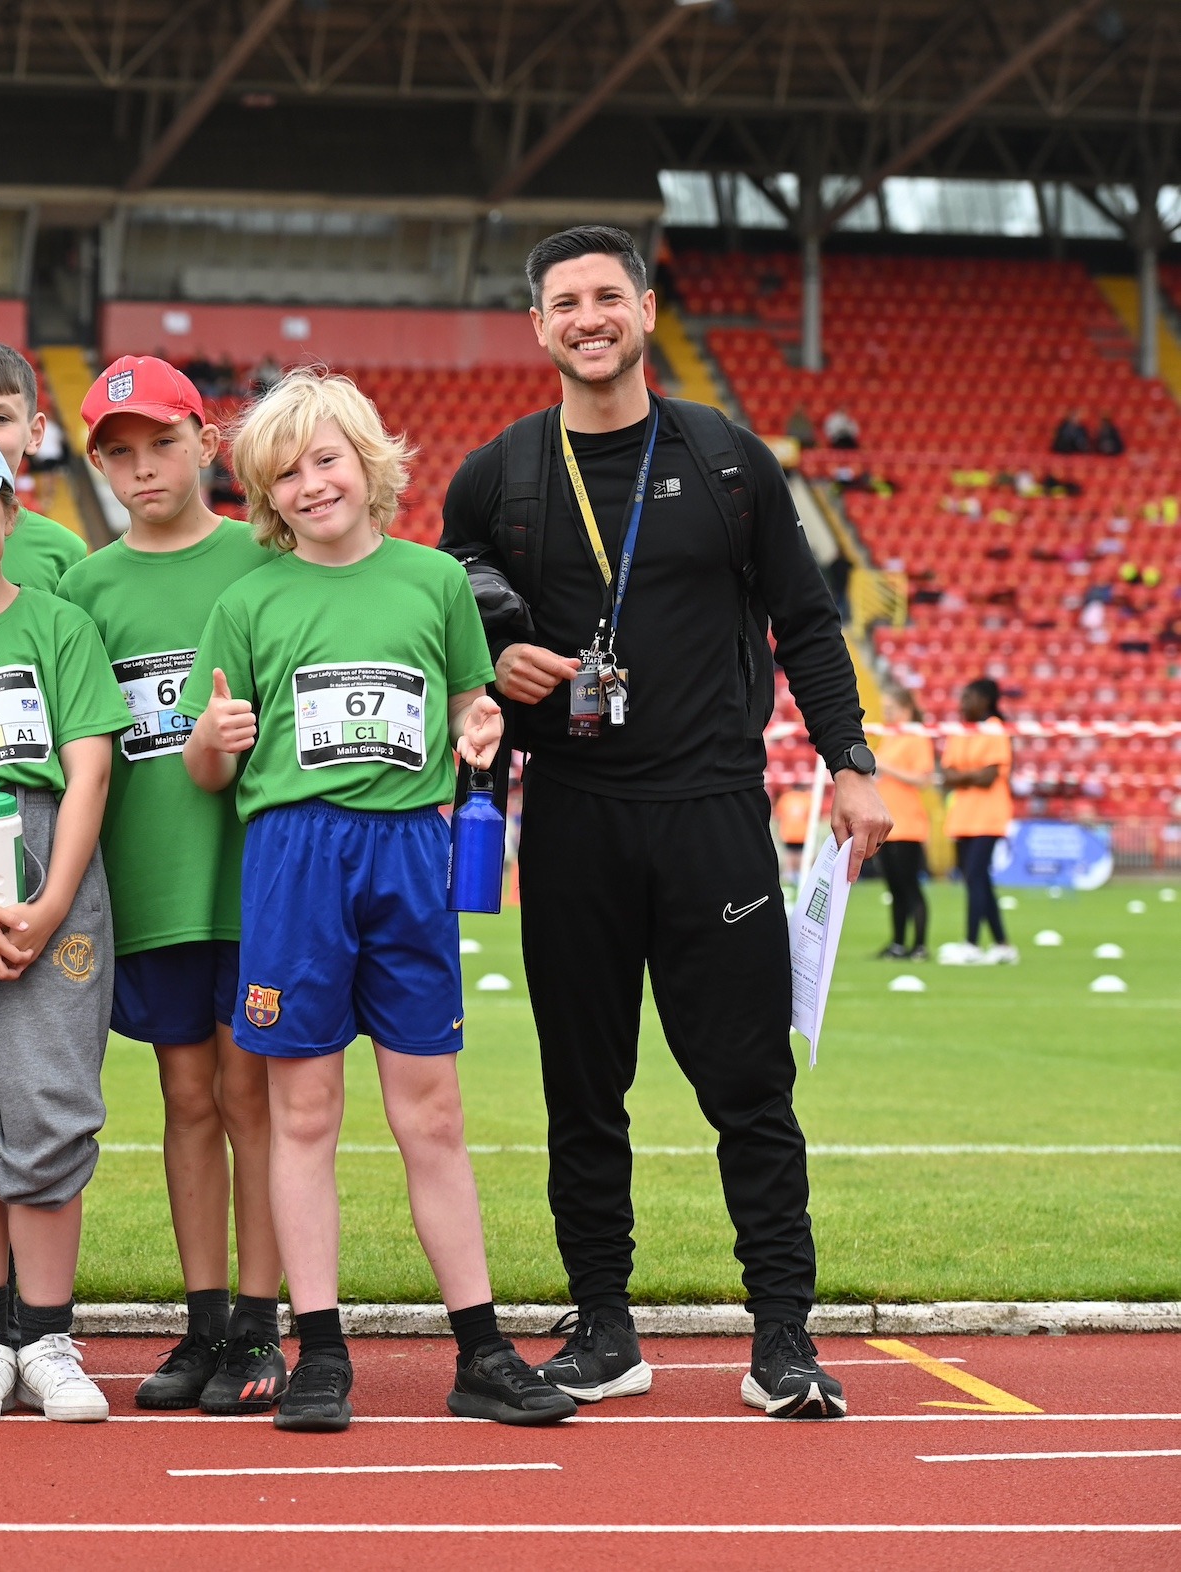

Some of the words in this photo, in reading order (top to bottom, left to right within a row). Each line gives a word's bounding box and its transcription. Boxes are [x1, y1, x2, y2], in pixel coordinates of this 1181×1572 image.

[654, 491, 681, 499] karrimor
[619, 570, 627, 593] OLOOP
[623, 552, 631, 571] STAFF
[397, 672, 415, 682] Primary
[157, 677, 187, 706] 6
[21, 699, 39, 710] SSP
[345, 691, 385, 716] 67
[171, 715, 191, 728] C1
[133, 721, 151, 736] B1
[355, 726, 377, 740] C1
[17, 729, 37, 742] A1
[155, 736, 175, 746] Main
[175, 734, 191, 742] Gro
[312, 731, 331, 746] B1
[397, 732, 413, 748] A1
[9, 748, 16, 756] 3
[337, 746, 358, 756] Main
[359, 745, 387, 754] Group:
